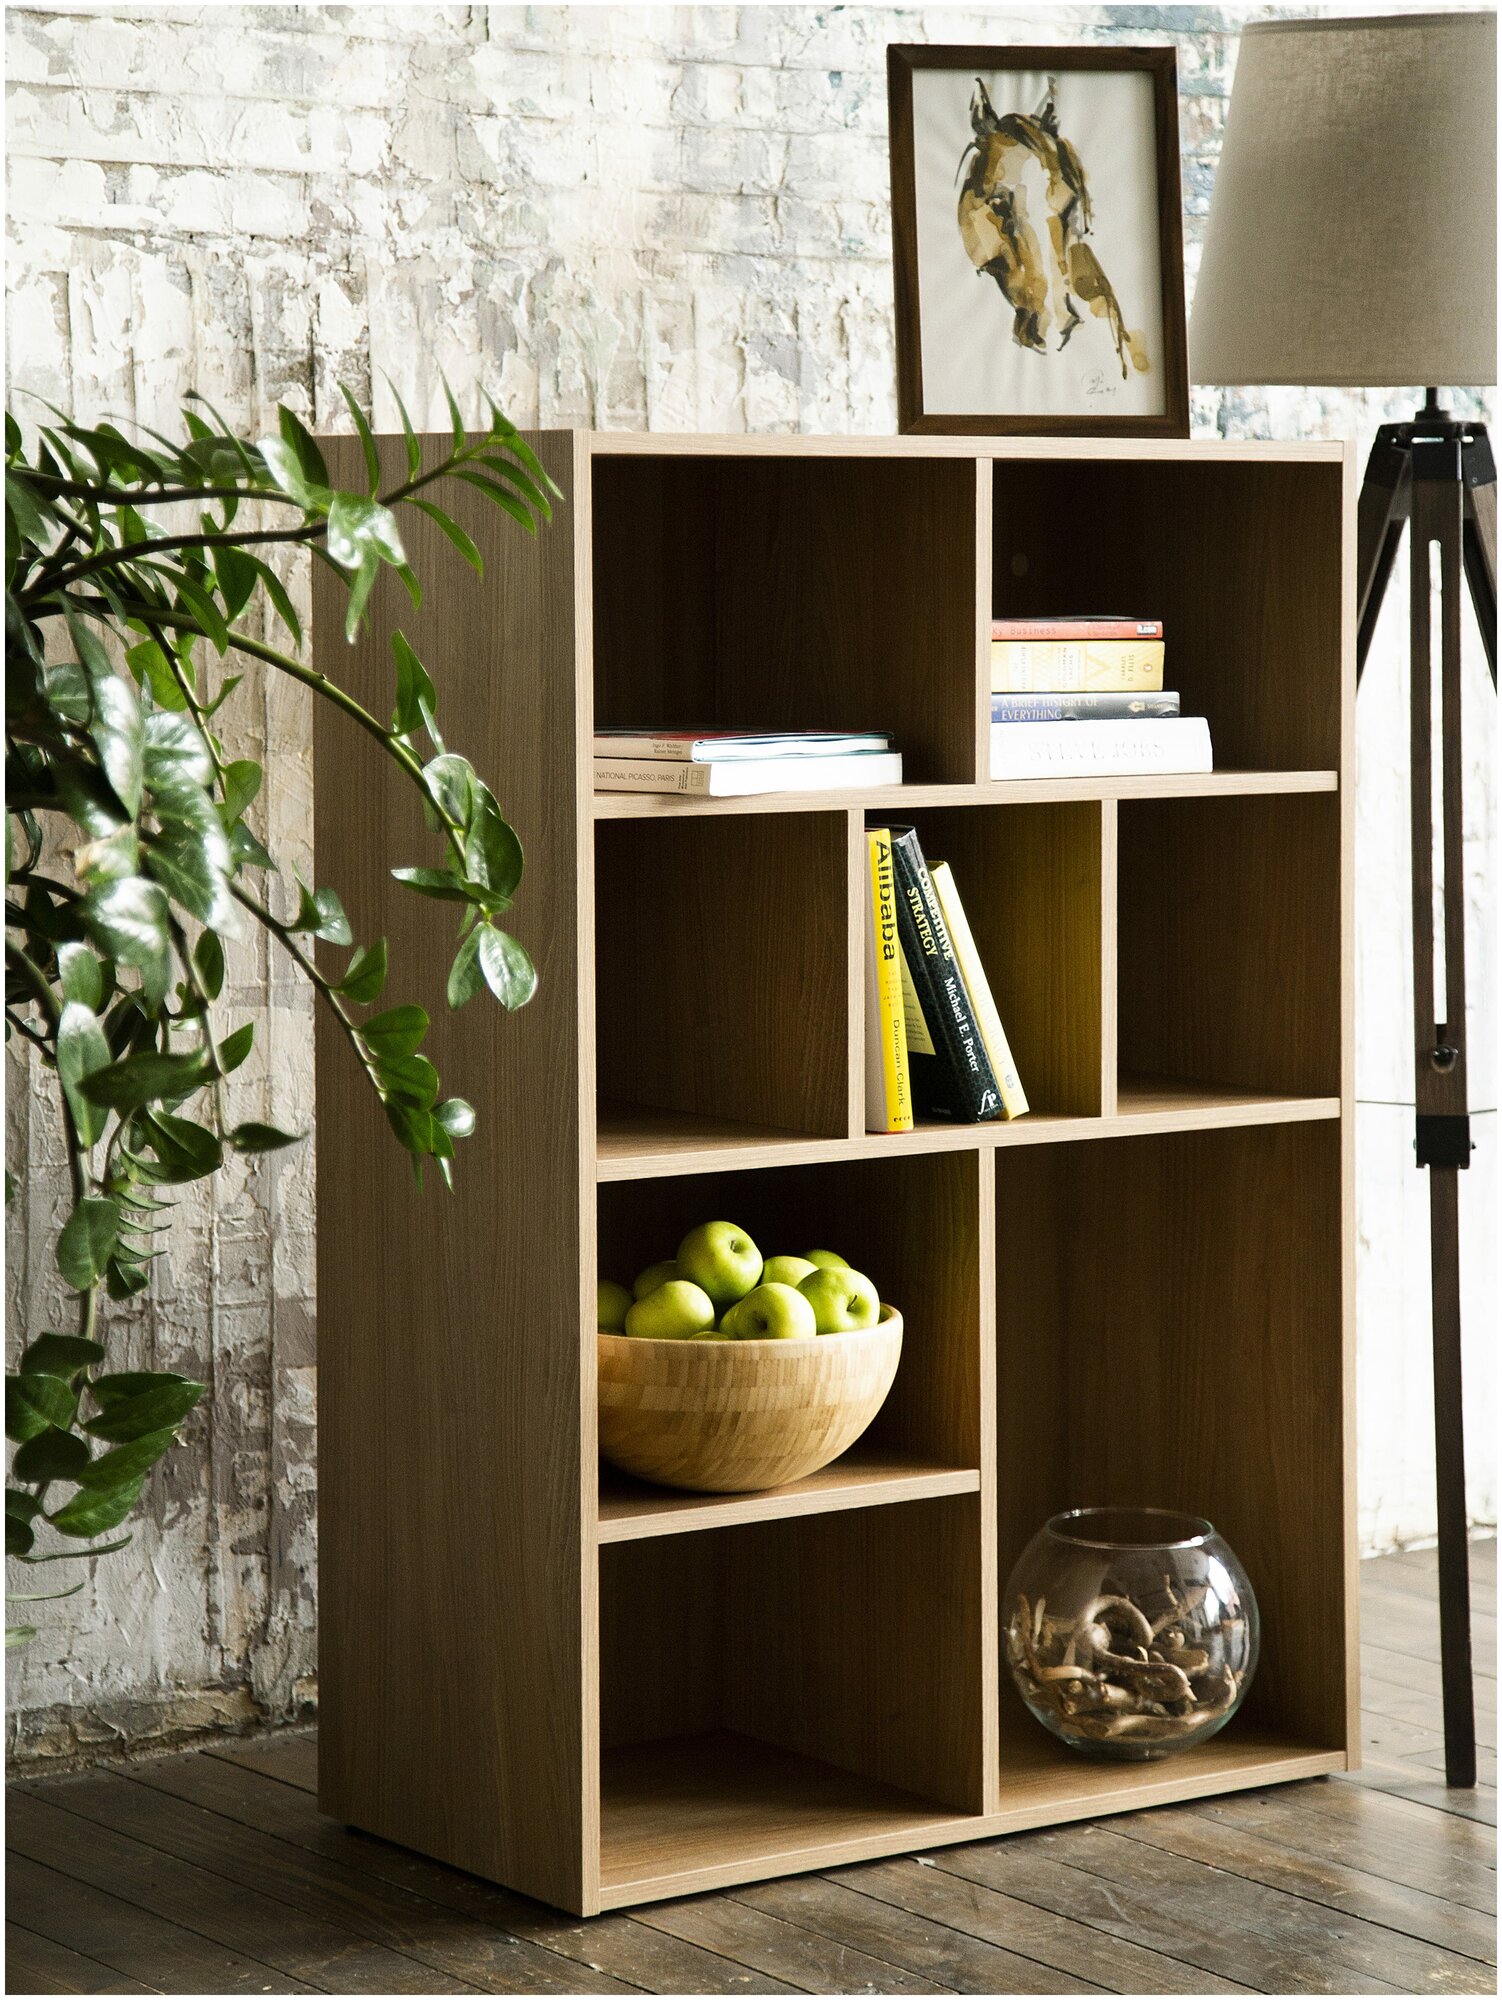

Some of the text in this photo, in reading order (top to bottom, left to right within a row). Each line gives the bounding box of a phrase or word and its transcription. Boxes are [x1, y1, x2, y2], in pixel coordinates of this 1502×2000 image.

[1010, 625, 1057, 635] Business
[1001, 708, 1062, 721] EVERYTHING
[1002, 697, 1009, 708] A
[1011, 697, 1040, 708] BRIEF
[596, 771, 626, 780] NATIONAL
[657, 774, 675, 782] PARIS
[876, 840, 896, 961] Alibaba
[907, 886, 939, 957] STRATEGY
[917, 866, 953, 961] COMPETITIVE
[944, 976, 980, 1073] Michael E. Porter
[893, 1019, 905, 1106] Duncan Clark
